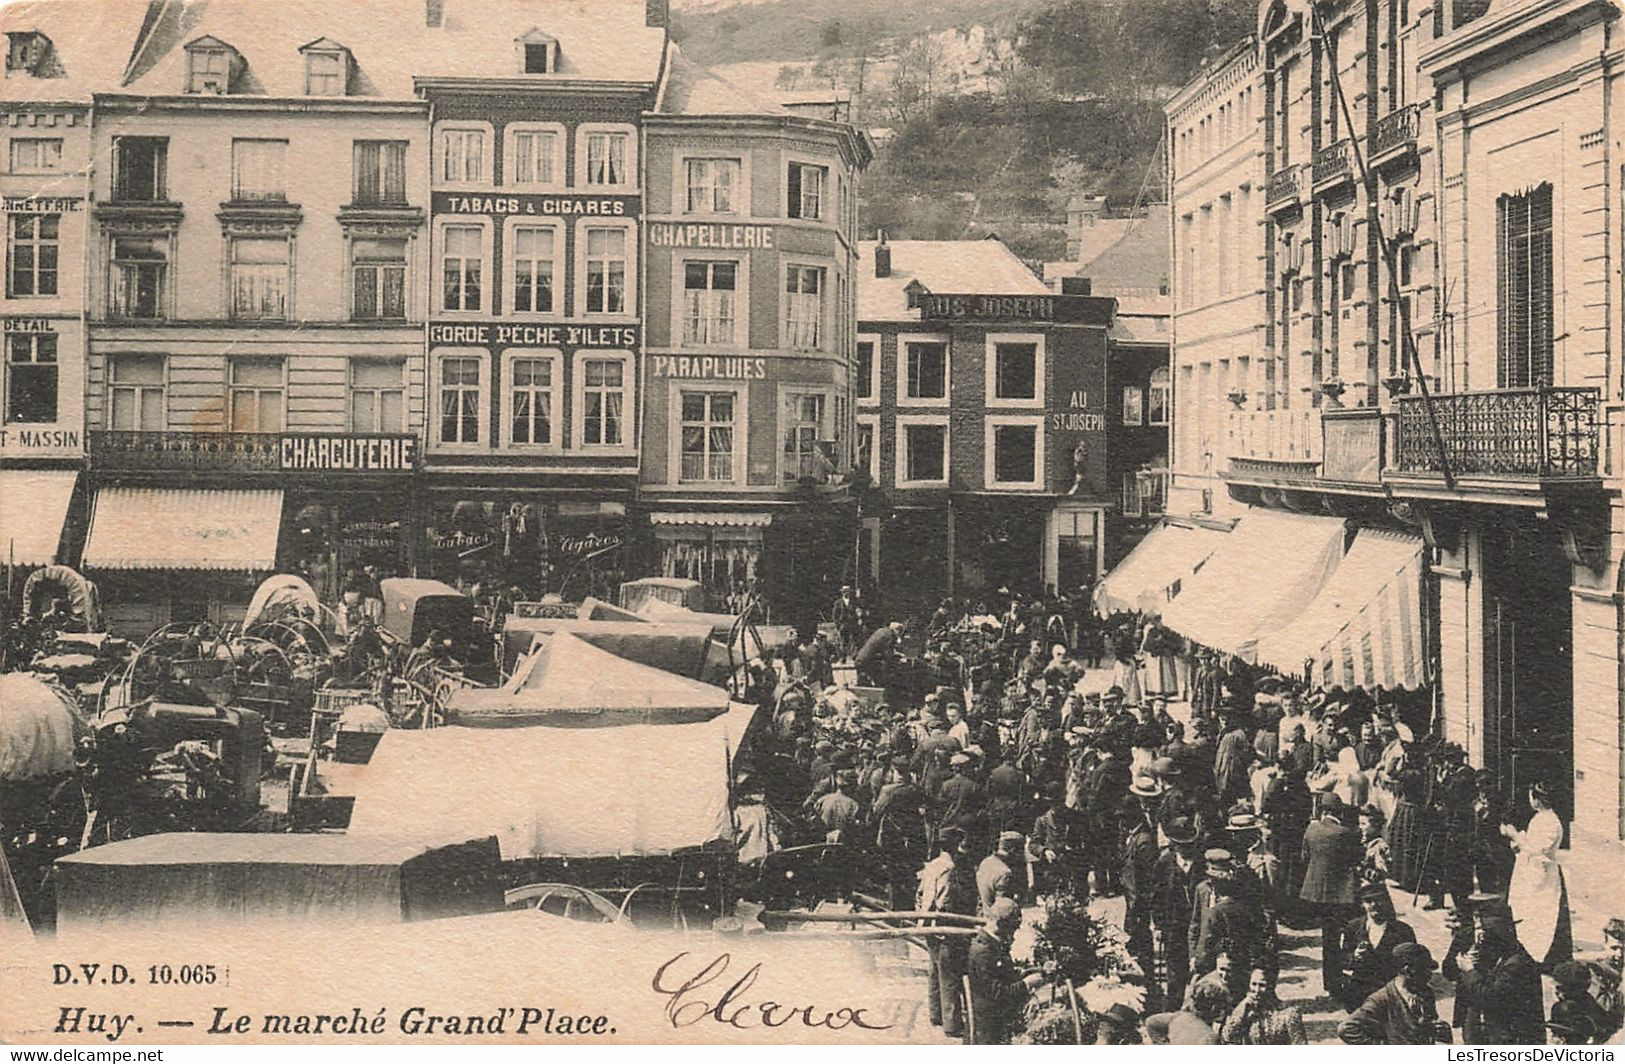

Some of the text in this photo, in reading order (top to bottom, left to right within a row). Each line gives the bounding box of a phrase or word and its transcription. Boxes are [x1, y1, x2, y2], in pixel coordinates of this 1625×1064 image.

[449, 198, 624, 214] TABACS & CIGARES
[651, 224, 773, 248] CHAPELLERIE
[567, 327, 635, 345] FILETS
[653, 355, 765, 379] PARAPLUIES
[1070, 391, 1087, 408] AU
[1065, 413, 1105, 431] JOSEPH
[281, 437, 414, 470] CHARCUTERIE
[53, 963, 217, 985] D.V.D. 10.065
[54, 1007, 143, 1041] Huy.
[207, 1007, 252, 1034] Le
[260, 1007, 386, 1034] marché
